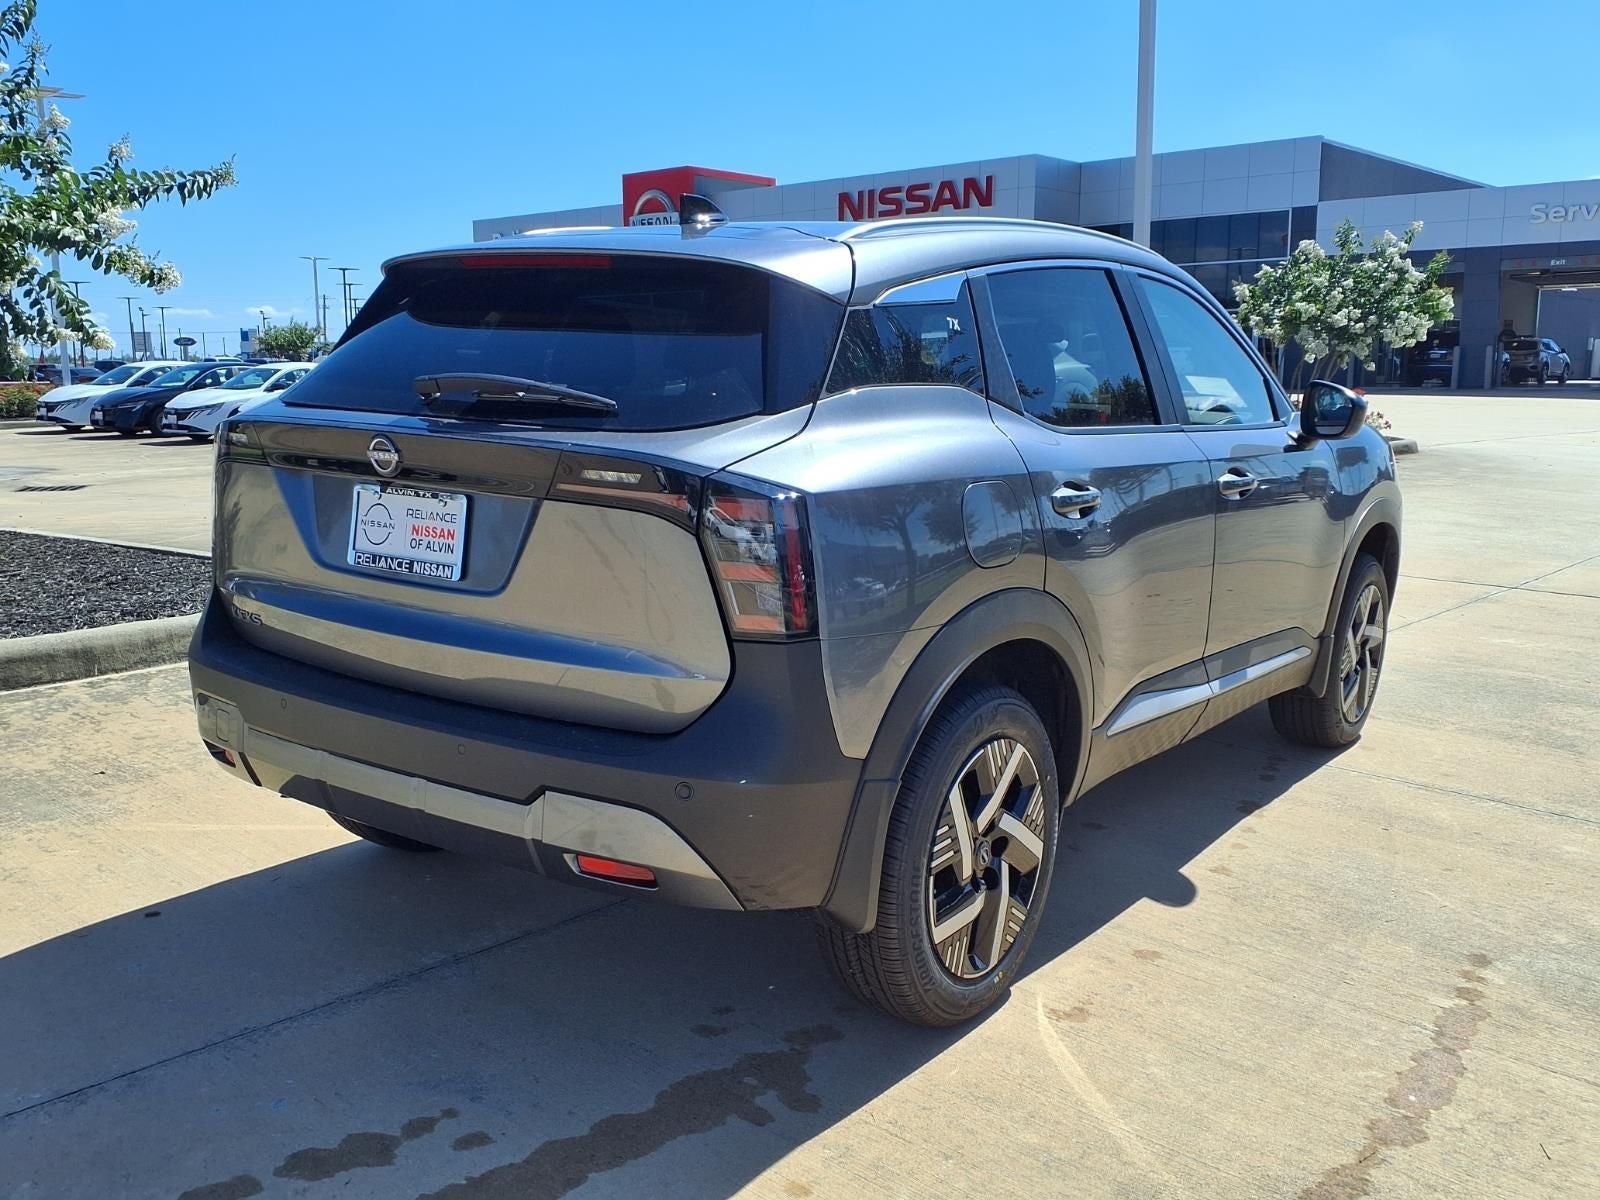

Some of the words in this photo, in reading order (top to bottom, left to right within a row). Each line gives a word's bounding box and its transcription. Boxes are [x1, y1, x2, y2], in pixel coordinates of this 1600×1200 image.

[838, 175, 994, 221] NISSAN
[1528, 203, 1600, 224] Serv
[1550, 259, 1566, 267] Exit
[367, 450, 398, 461] NISSAN
[360, 518, 396, 530] NISSAN
[406, 508, 458, 524] RELIANCE
[411, 523, 456, 541] NISSAN
[409, 537, 423, 550] OF
[425, 540, 455, 554] ALVIN
[355, 552, 411, 572] RELIANCE
[412, 560, 453, 578] NISSAN
